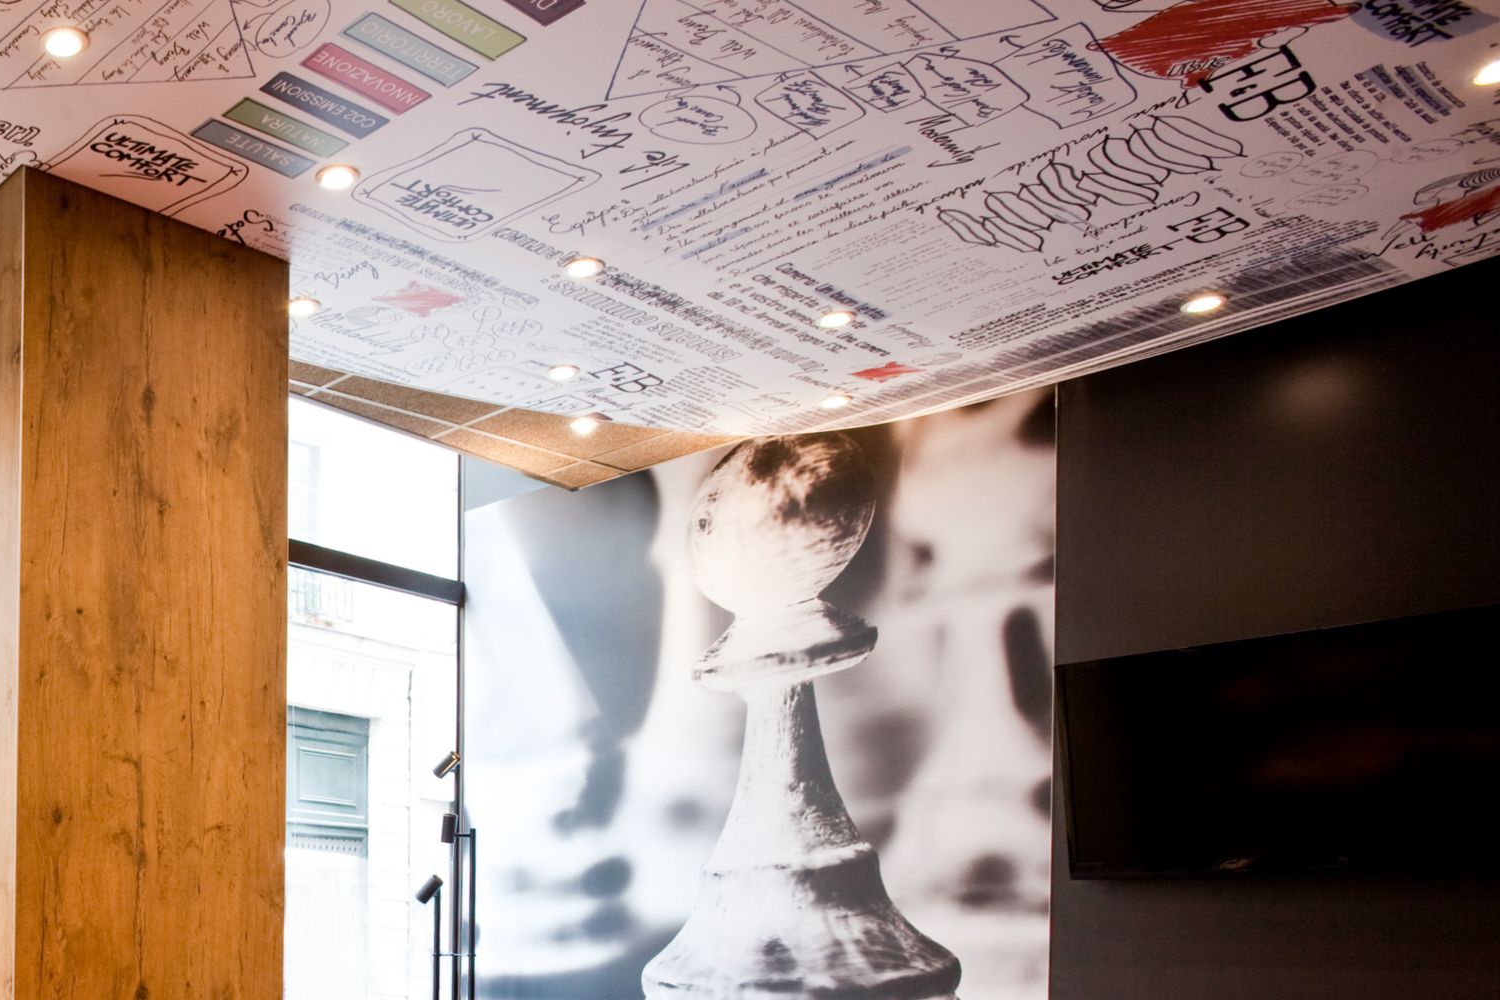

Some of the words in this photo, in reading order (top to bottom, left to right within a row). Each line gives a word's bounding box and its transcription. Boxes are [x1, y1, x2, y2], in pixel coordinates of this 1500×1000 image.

[420, 0, 496, 41] LAVORO
[360, 22, 462, 82] TERRITORIO
[271, 79, 344, 118] EMISSIONI
[312, 50, 422, 106] INNOVAZIONE
[260, 114, 323, 148] NATURA
[341, 111, 375, 129] CO2
[89, 140, 208, 188] COMFORT
[102, 131, 201, 173] ULTIMATE
[227, 133, 296, 167] SALUTE
[389, 178, 496, 225] COMFORT
[396, 191, 480, 231] ULTIMATE
[1051, 242, 1154, 282] ULTIMATE
[1056, 240, 1185, 286] COMFORT
[776, 263, 819, 290] Camera:
[830, 290, 858, 306] buon
[855, 303, 887, 320] letto
[778, 285, 819, 308] rispetta
